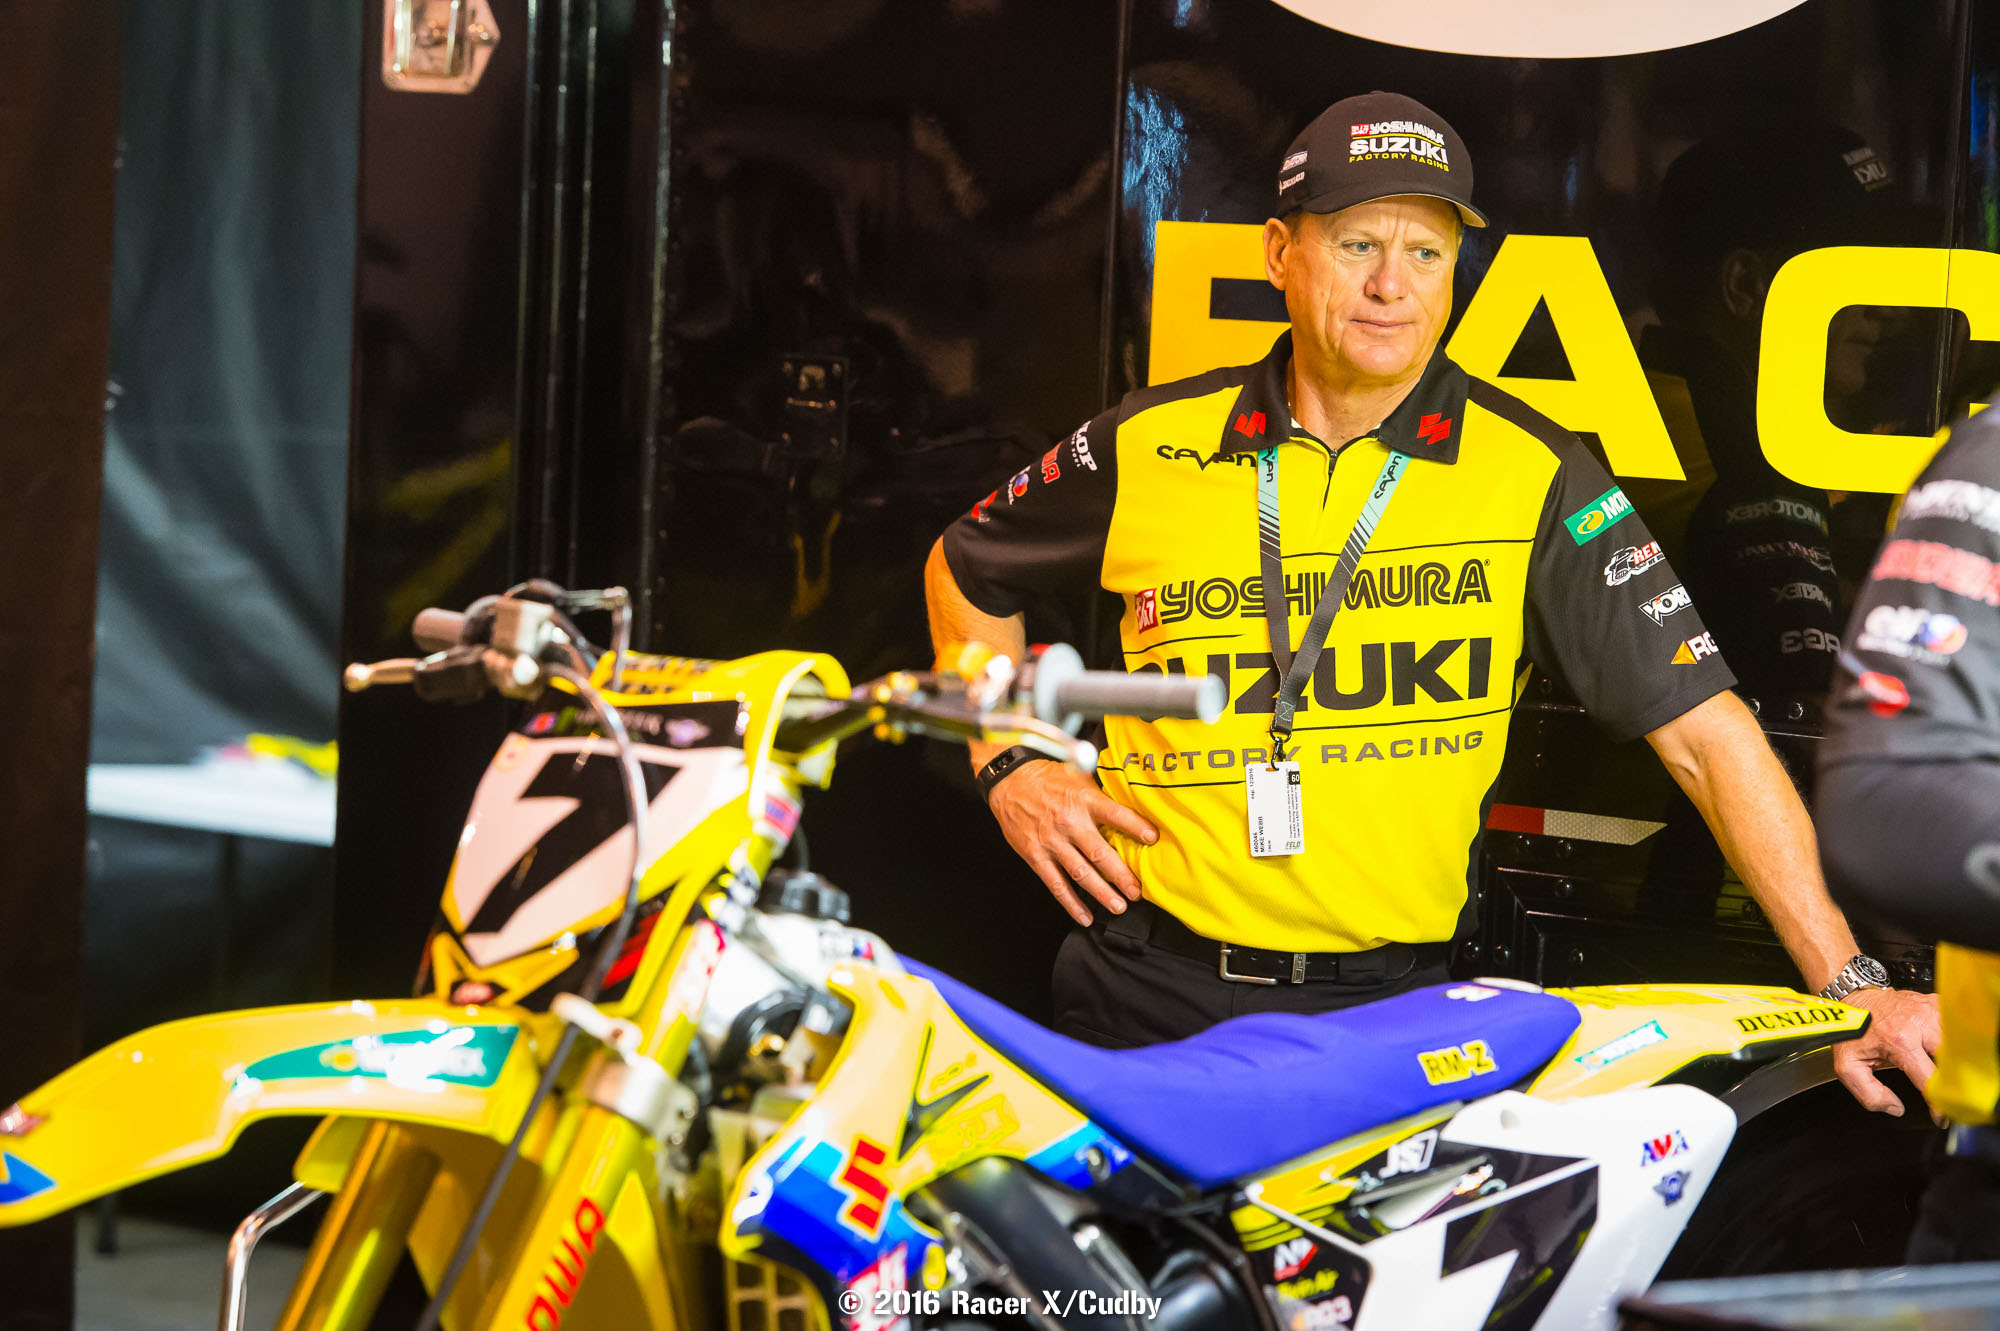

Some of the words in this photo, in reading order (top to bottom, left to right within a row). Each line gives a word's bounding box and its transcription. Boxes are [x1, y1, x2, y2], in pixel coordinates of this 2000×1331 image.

[1370, 121, 1445, 146] YOSHIMURA
[1349, 137, 1449, 165] SUZUKI
[1349, 152, 1408, 164] FACTORY
[1410, 153, 1450, 172] RACING
[1076, 420, 1098, 471] LOP
[1321, 730, 1484, 764] RACING
[464, 751, 685, 936] 7
[1736, 1007, 1845, 1033] DUNLOP
[1422, 1046, 1496, 1081] RM-Z
